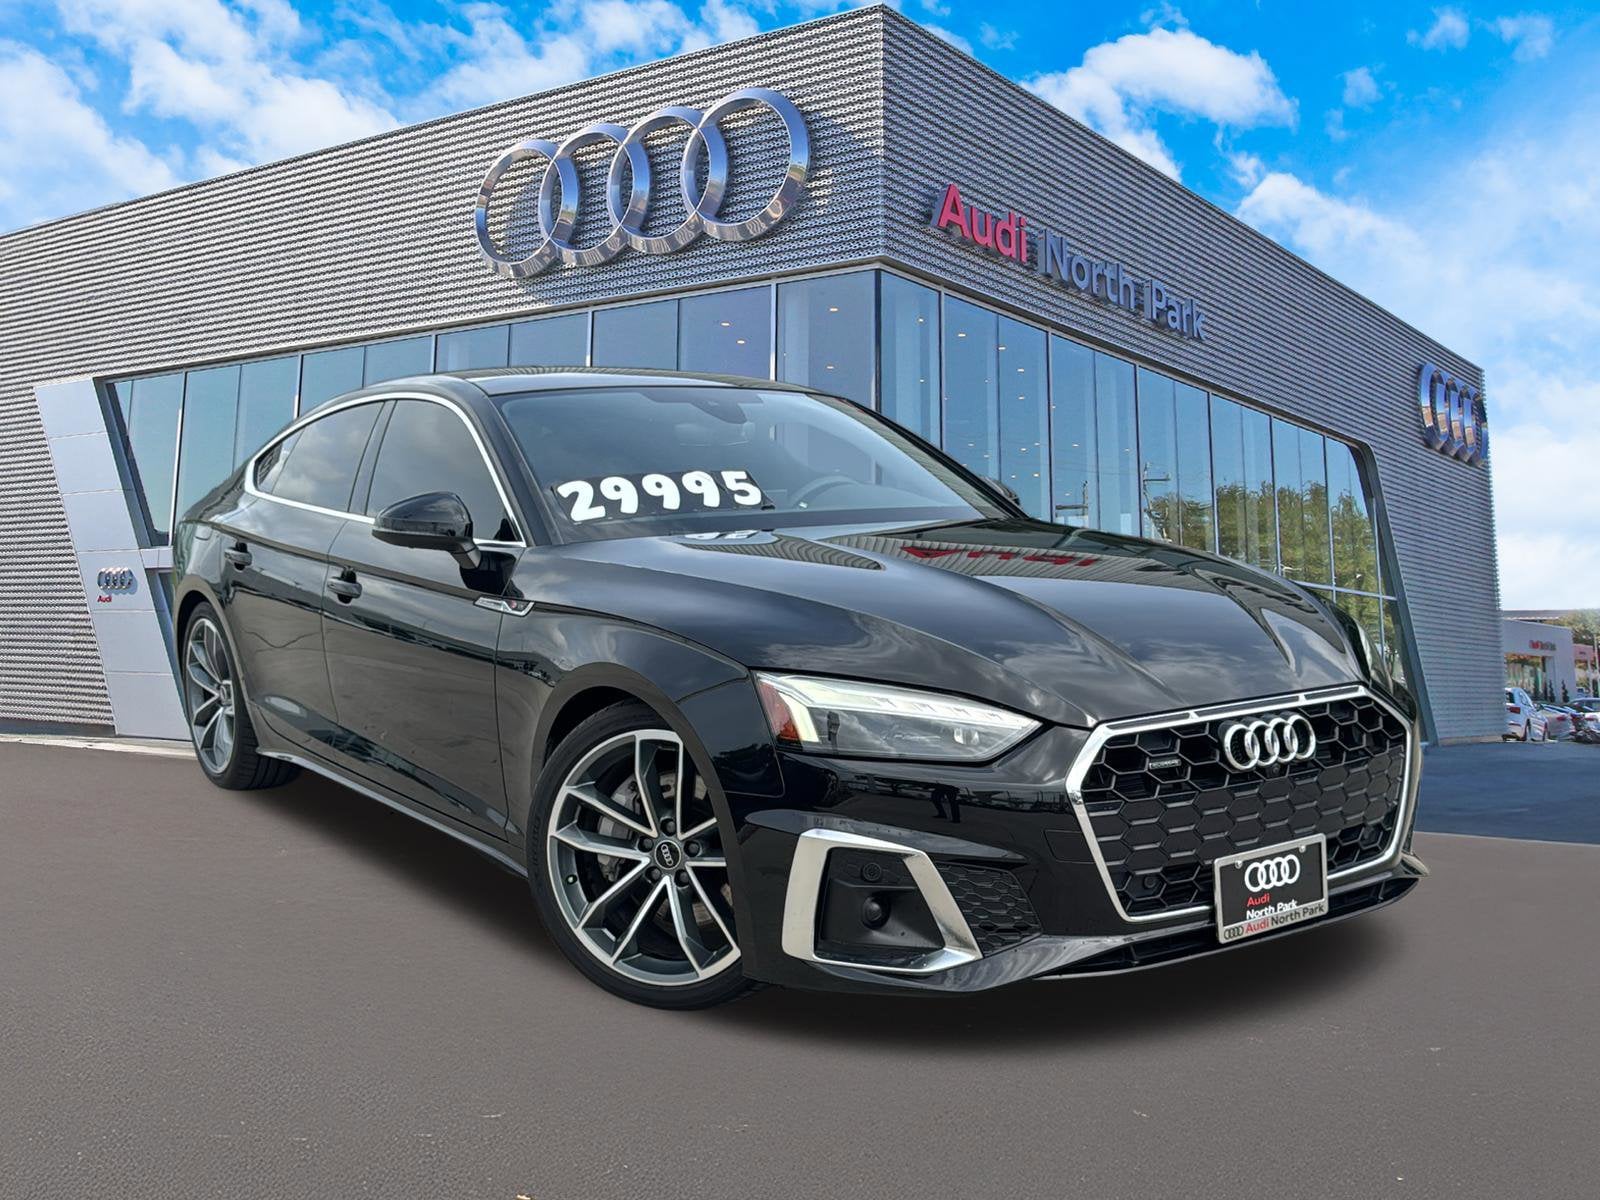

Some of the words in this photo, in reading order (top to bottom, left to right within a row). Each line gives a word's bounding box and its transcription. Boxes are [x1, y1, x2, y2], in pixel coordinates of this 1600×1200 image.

[931, 183, 1028, 263] Audi
[1037, 228, 1136, 312] North
[1143, 279, 1207, 340] Park
[557, 470, 762, 521] 29995
[1246, 905, 1275, 920] North
[1277, 899, 1298, 912] Park
[1247, 893, 1270, 907] Audi
[1245, 919, 1270, 934] Audi
[1271, 911, 1301, 926] North
[1303, 904, 1325, 918] Park
